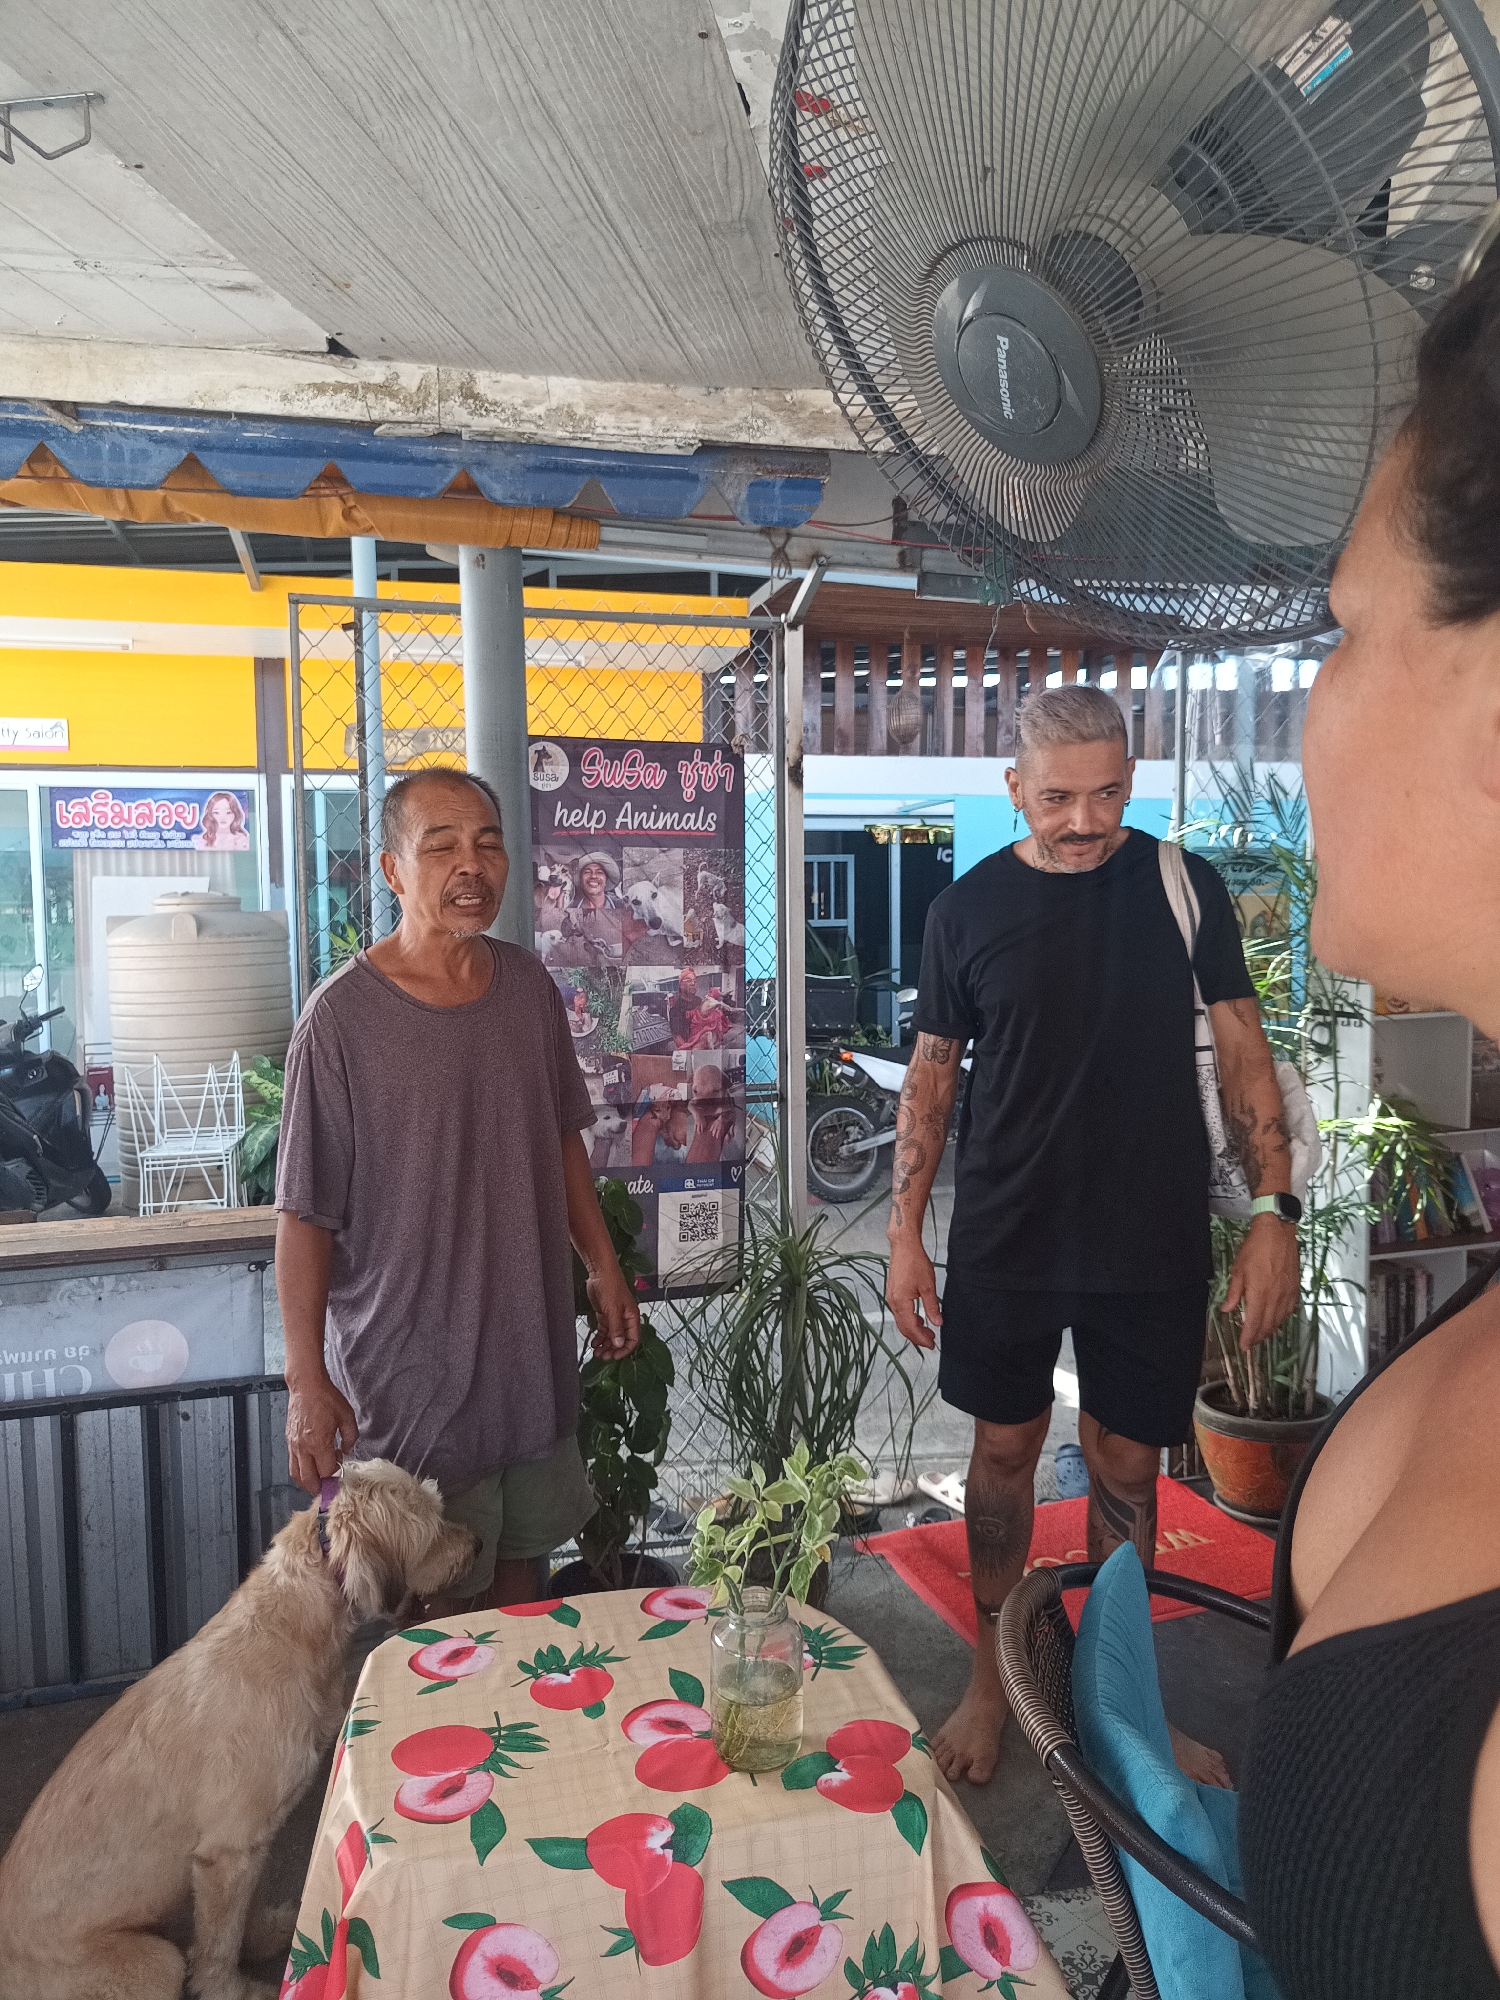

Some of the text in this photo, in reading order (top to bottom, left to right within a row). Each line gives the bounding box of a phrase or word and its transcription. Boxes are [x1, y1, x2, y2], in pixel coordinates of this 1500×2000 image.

[996, 334, 1015, 421] Panasonic
[57, 789, 199, 828] เสริมสวย
[554, 800, 717, 834] help Animals
